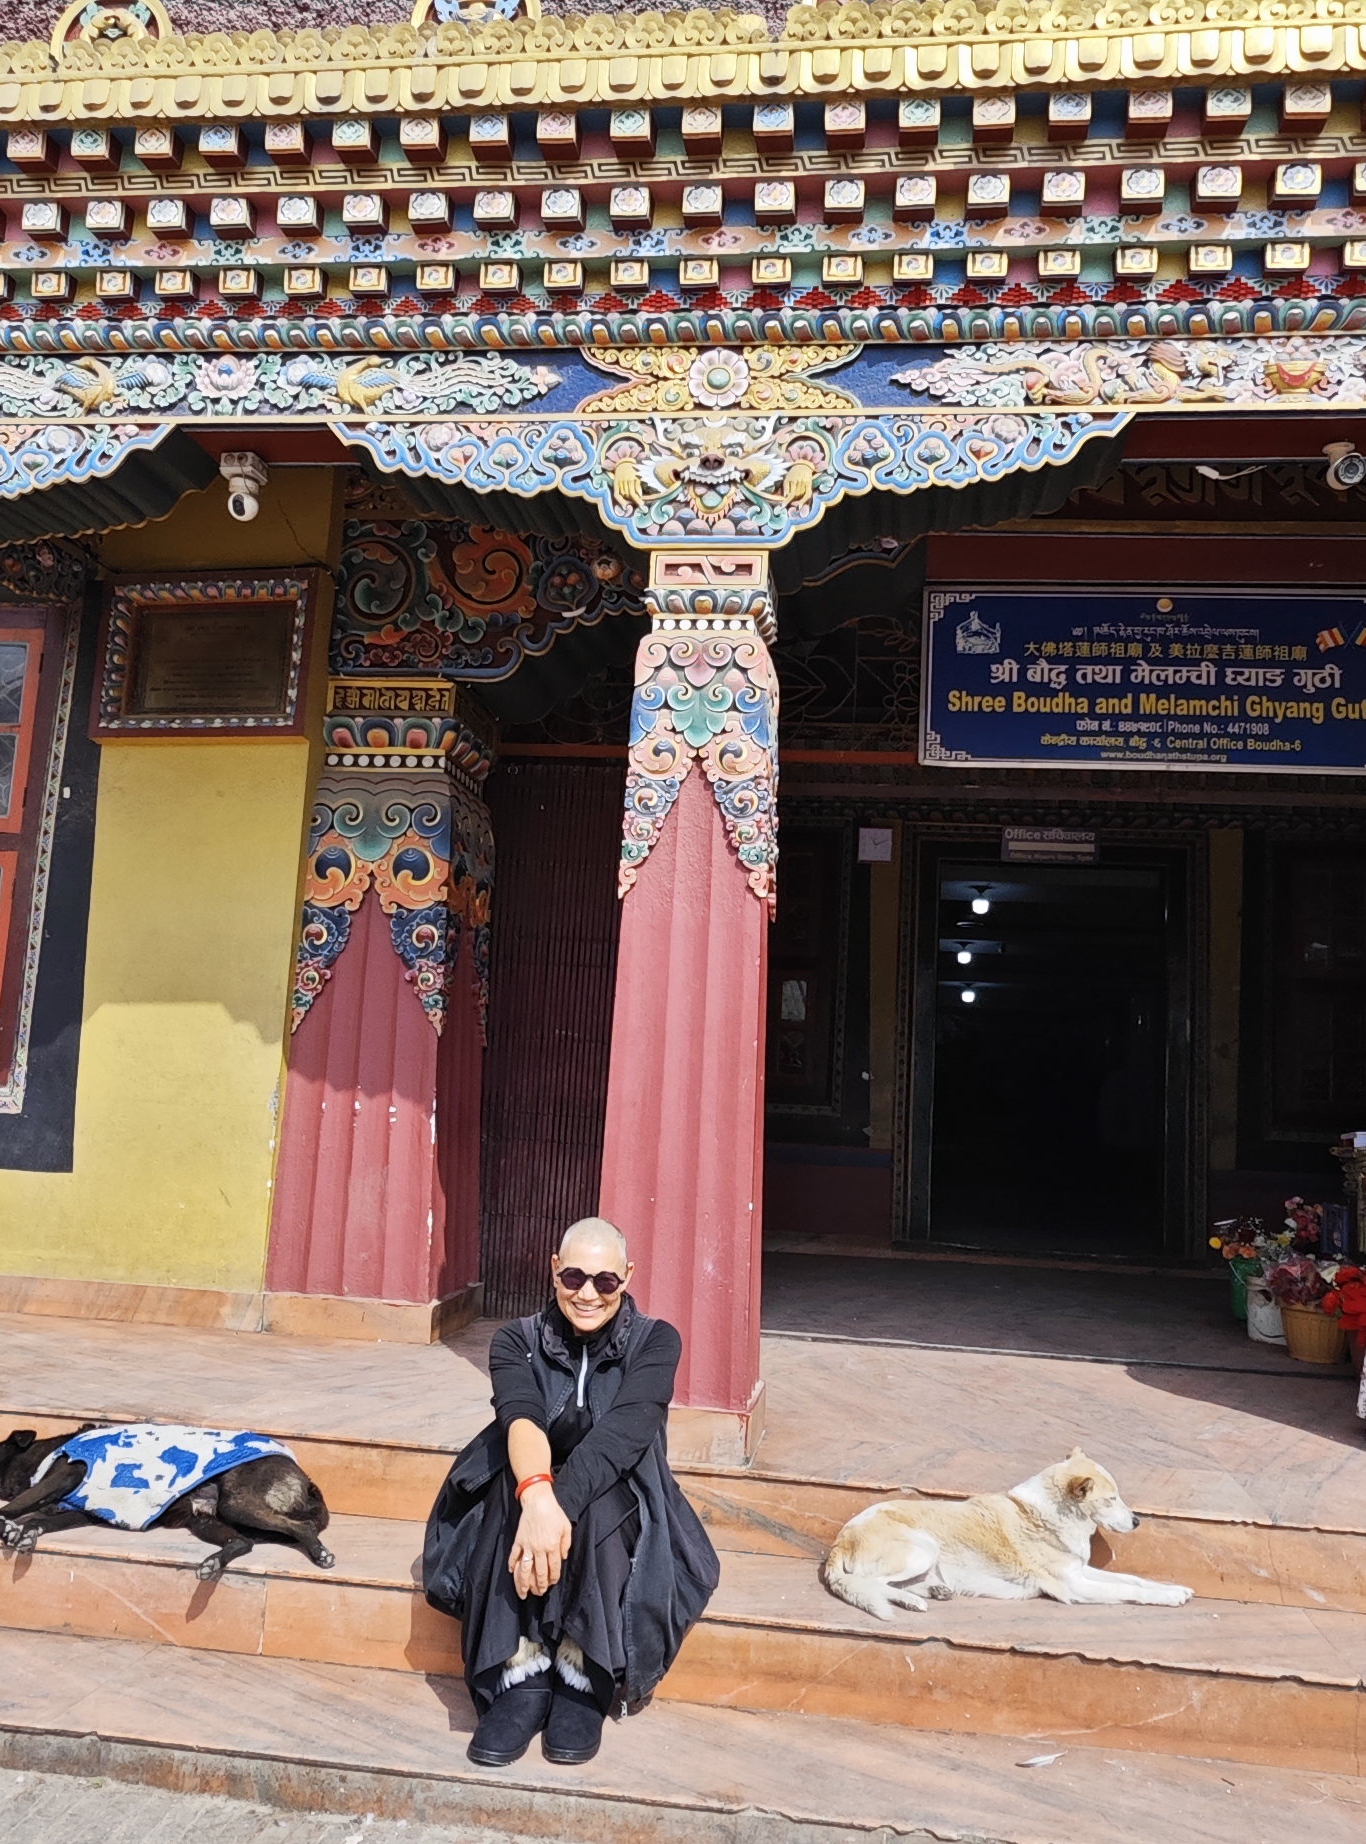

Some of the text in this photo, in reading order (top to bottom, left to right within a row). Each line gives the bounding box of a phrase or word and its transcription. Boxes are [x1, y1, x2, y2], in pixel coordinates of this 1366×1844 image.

[1148, 643, 1163, 658] 及
[990, 658, 1343, 693] श्री बौद्ध तथा मेलम्ची घ्याङ गुठी
[948, 690, 1006, 712] Shree
[1013, 691, 1089, 714] Boudha
[1095, 693, 1133, 714] and
[1139, 693, 1239, 717] Melamchi
[1246, 695, 1324, 724] Ghyang
[1076, 717, 1099, 732] फोन
[1167, 721, 1201, 734] Phone
[1203, 722, 1225, 734] No.:
[1227, 722, 1270, 735] 4471908
[1166, 736, 1207, 749] Central
[1210, 737, 1243, 750] Office
[1247, 739, 1302, 751] Boudha-6
[1005, 828, 1041, 840] Office
